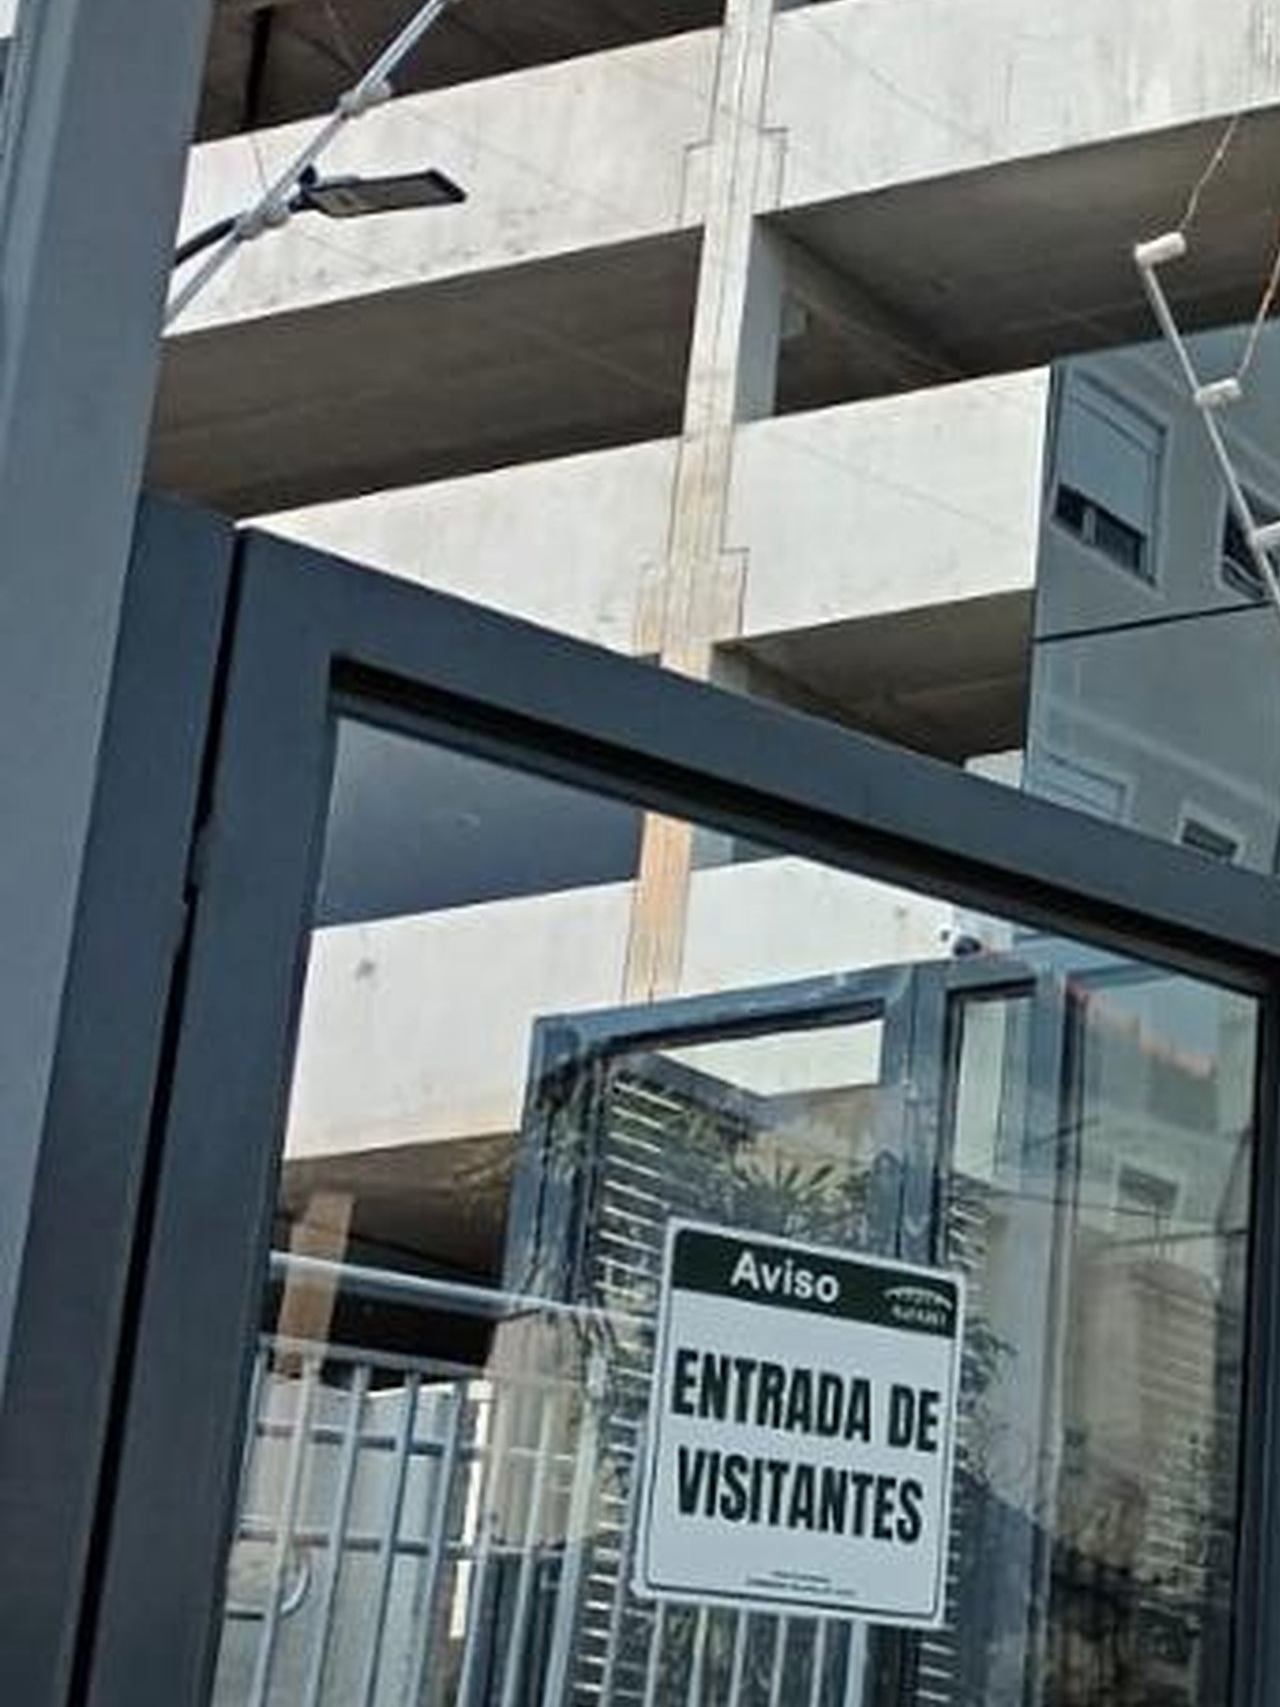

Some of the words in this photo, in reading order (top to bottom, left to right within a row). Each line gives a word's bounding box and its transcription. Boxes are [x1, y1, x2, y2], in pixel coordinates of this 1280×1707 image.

[730, 1251, 841, 1303] Aviso
[671, 1347, 871, 1443] ENTRADA
[888, 1383, 940, 1453] DE
[678, 1445, 923, 1543] VISITANTES
